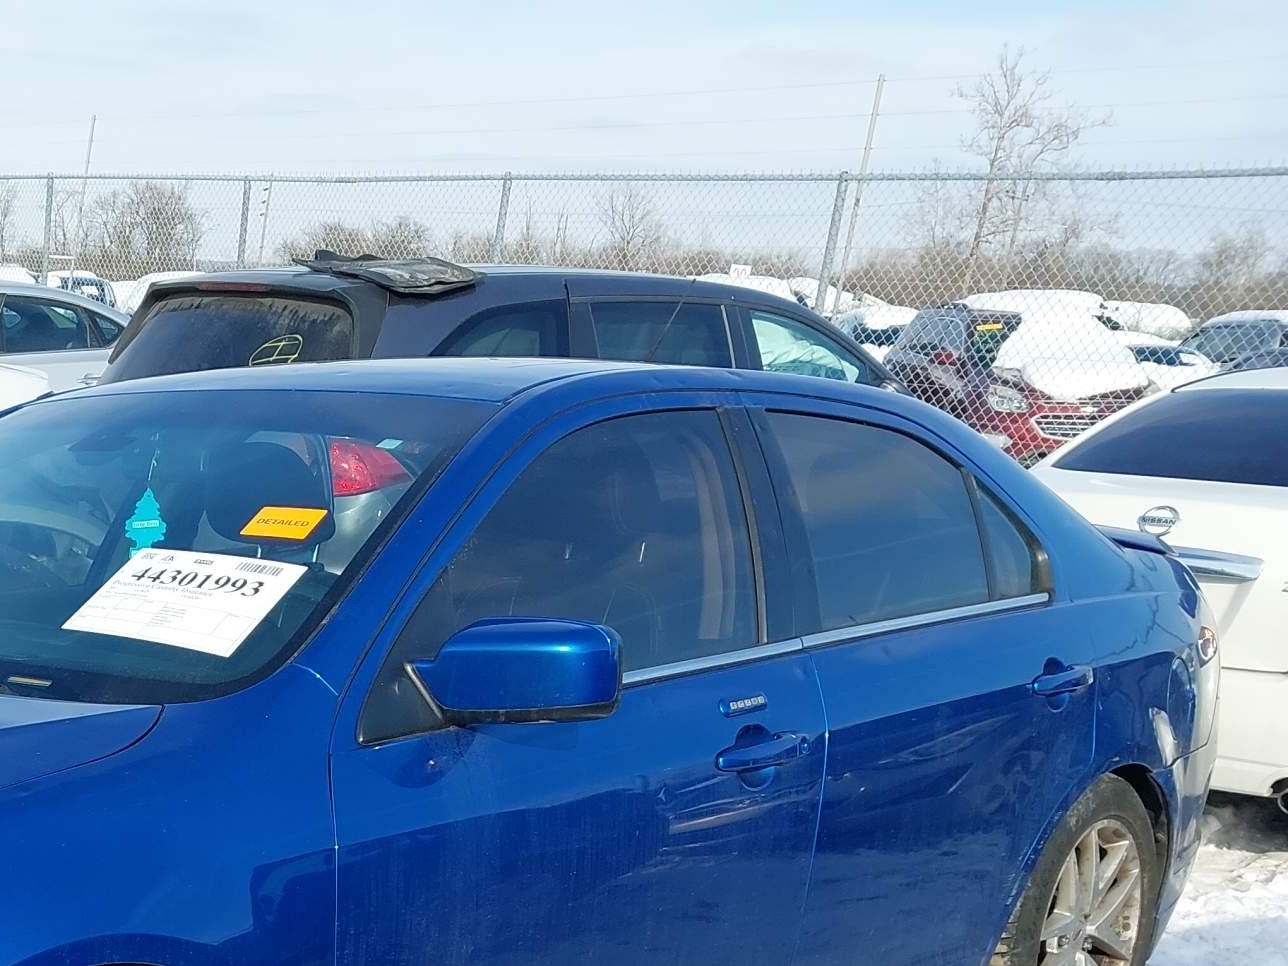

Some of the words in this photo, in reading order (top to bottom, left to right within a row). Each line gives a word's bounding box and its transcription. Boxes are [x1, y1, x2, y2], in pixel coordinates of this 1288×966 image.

[256, 518, 310, 528] DETAILED
[1141, 515, 1177, 526] NISSAN
[131, 566, 265, 597] 44301993
